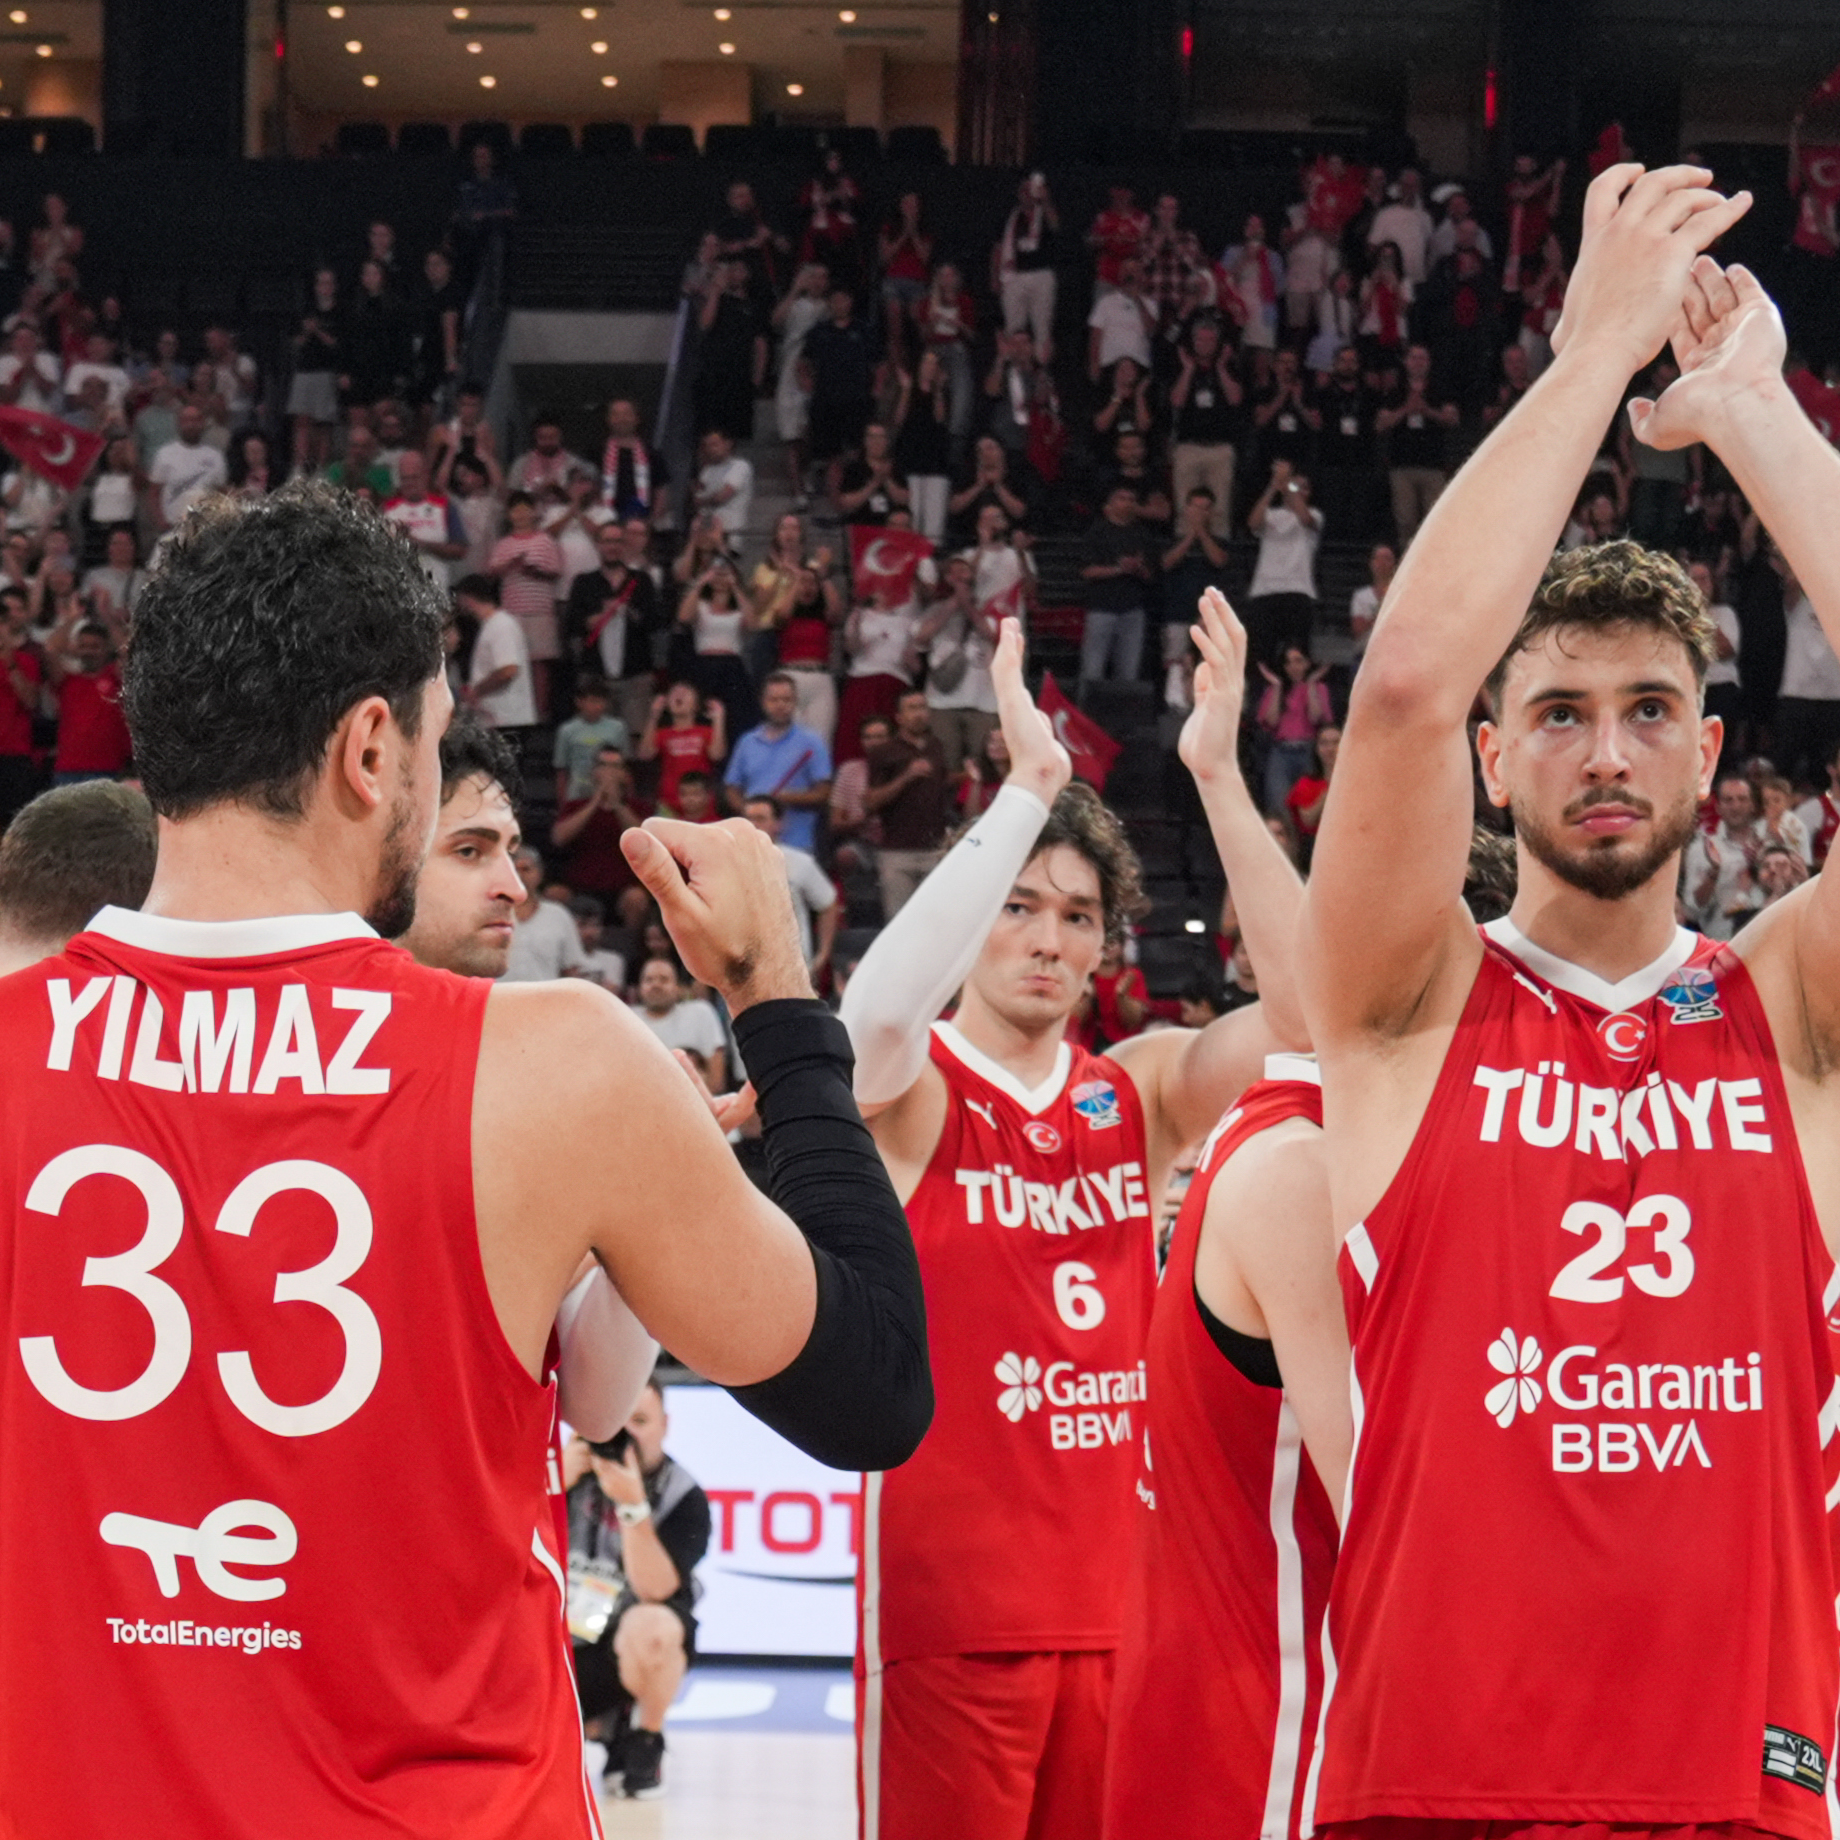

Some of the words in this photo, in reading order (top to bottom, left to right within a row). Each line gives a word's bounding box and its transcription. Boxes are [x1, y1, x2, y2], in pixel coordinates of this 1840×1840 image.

[47, 975, 392, 1095] YILMAZ
[1473, 1061, 1773, 1164] TÜRKİYE
[955, 1162, 1149, 1235] TÜRKİYE
[1549, 1194, 1695, 1303] 23
[19, 1144, 382, 1437] 33
[1052, 1261, 1106, 1331] 6
[1547, 1345, 1763, 1413] Garanti
[1552, 1419, 1712, 1473] BBVA
[705, 1489, 860, 1555] TOT
[106, 1618, 302, 1654] TotalEnergies
[1802, 1745, 1823, 1773] 2XL
